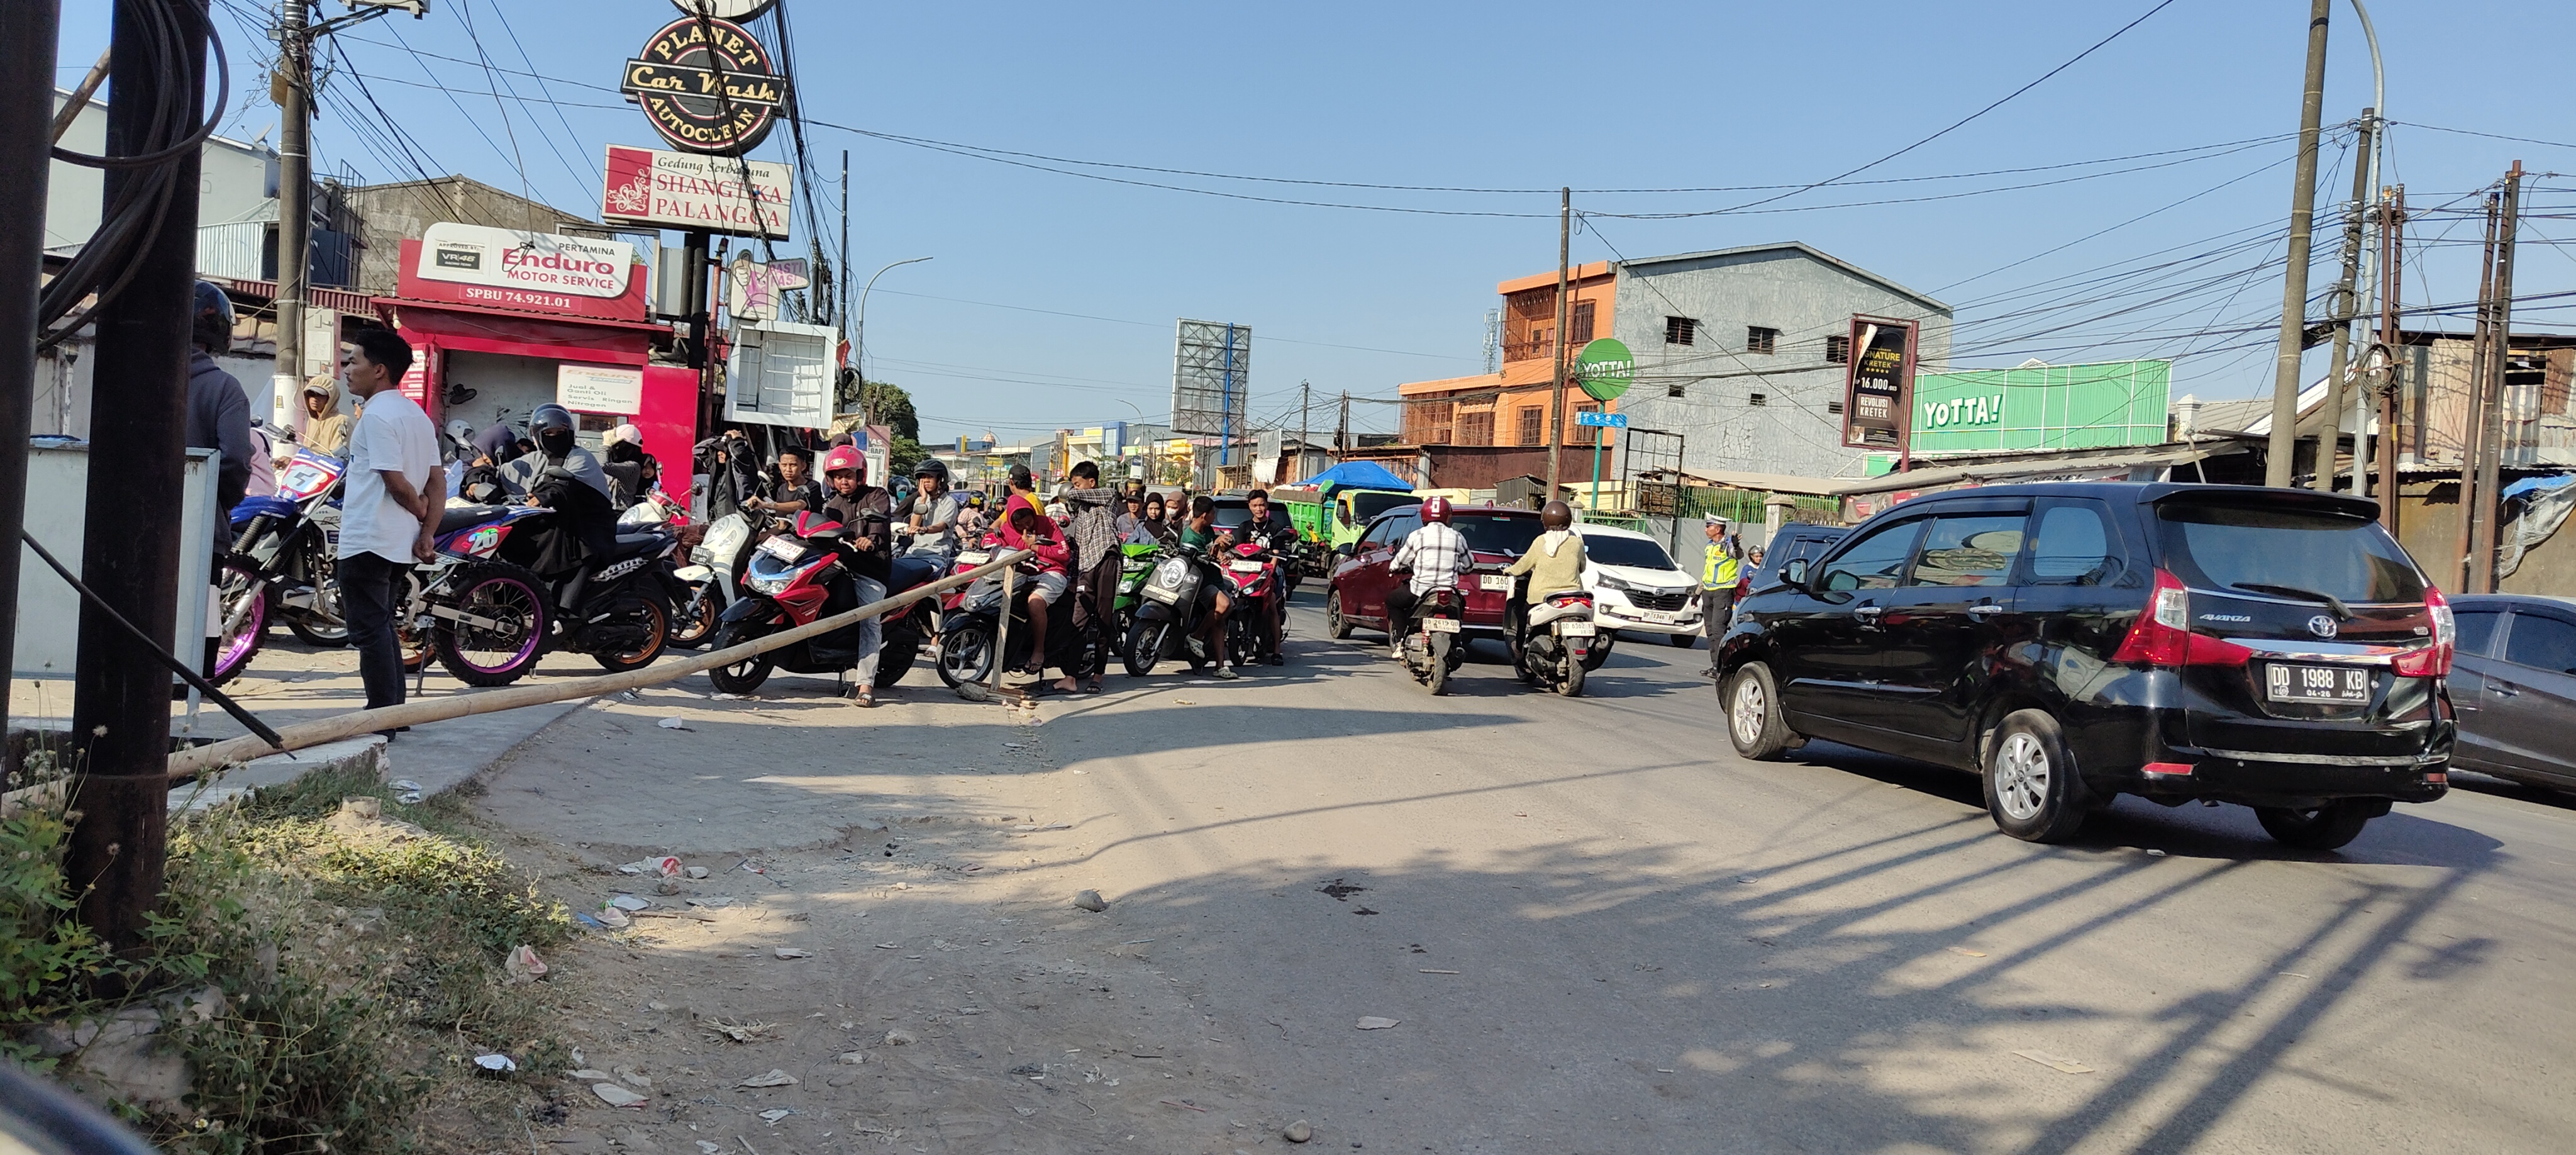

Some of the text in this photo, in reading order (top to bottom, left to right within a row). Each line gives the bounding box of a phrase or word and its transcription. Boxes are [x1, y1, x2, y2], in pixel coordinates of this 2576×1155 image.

[654, 25, 758, 67] PLANET
[631, 66, 777, 101] Car Wash
[650, 98, 755, 142] AUTOCLEAN
[658, 157, 770, 177] Gedung Serbauna
[657, 174, 782, 203] SHANGTKA
[558, 243, 615, 256] PERTAMINA
[502, 248, 614, 275] Enduro
[507, 271, 614, 289] MOTOR SERVICE
[466, 287, 571, 308] SPBU 74.921.01
[1863, 359, 1892, 369] KRETEK
[1864, 350, 1901, 362] GNATURE
[1582, 360, 1631, 378] YOTTA!
[1861, 377, 1888, 390] 16.000
[1860, 396, 1888, 408] REVOLUSI
[1923, 393, 2004, 429] YOTTA!
[1860, 406, 1887, 418] KRETEK
[468, 528, 498, 554] 26
[1483, 576, 1509, 585] DD 160
[2199, 613, 2251, 622] AVANZA
[2272, 667, 2364, 690] DD 1988 KB
